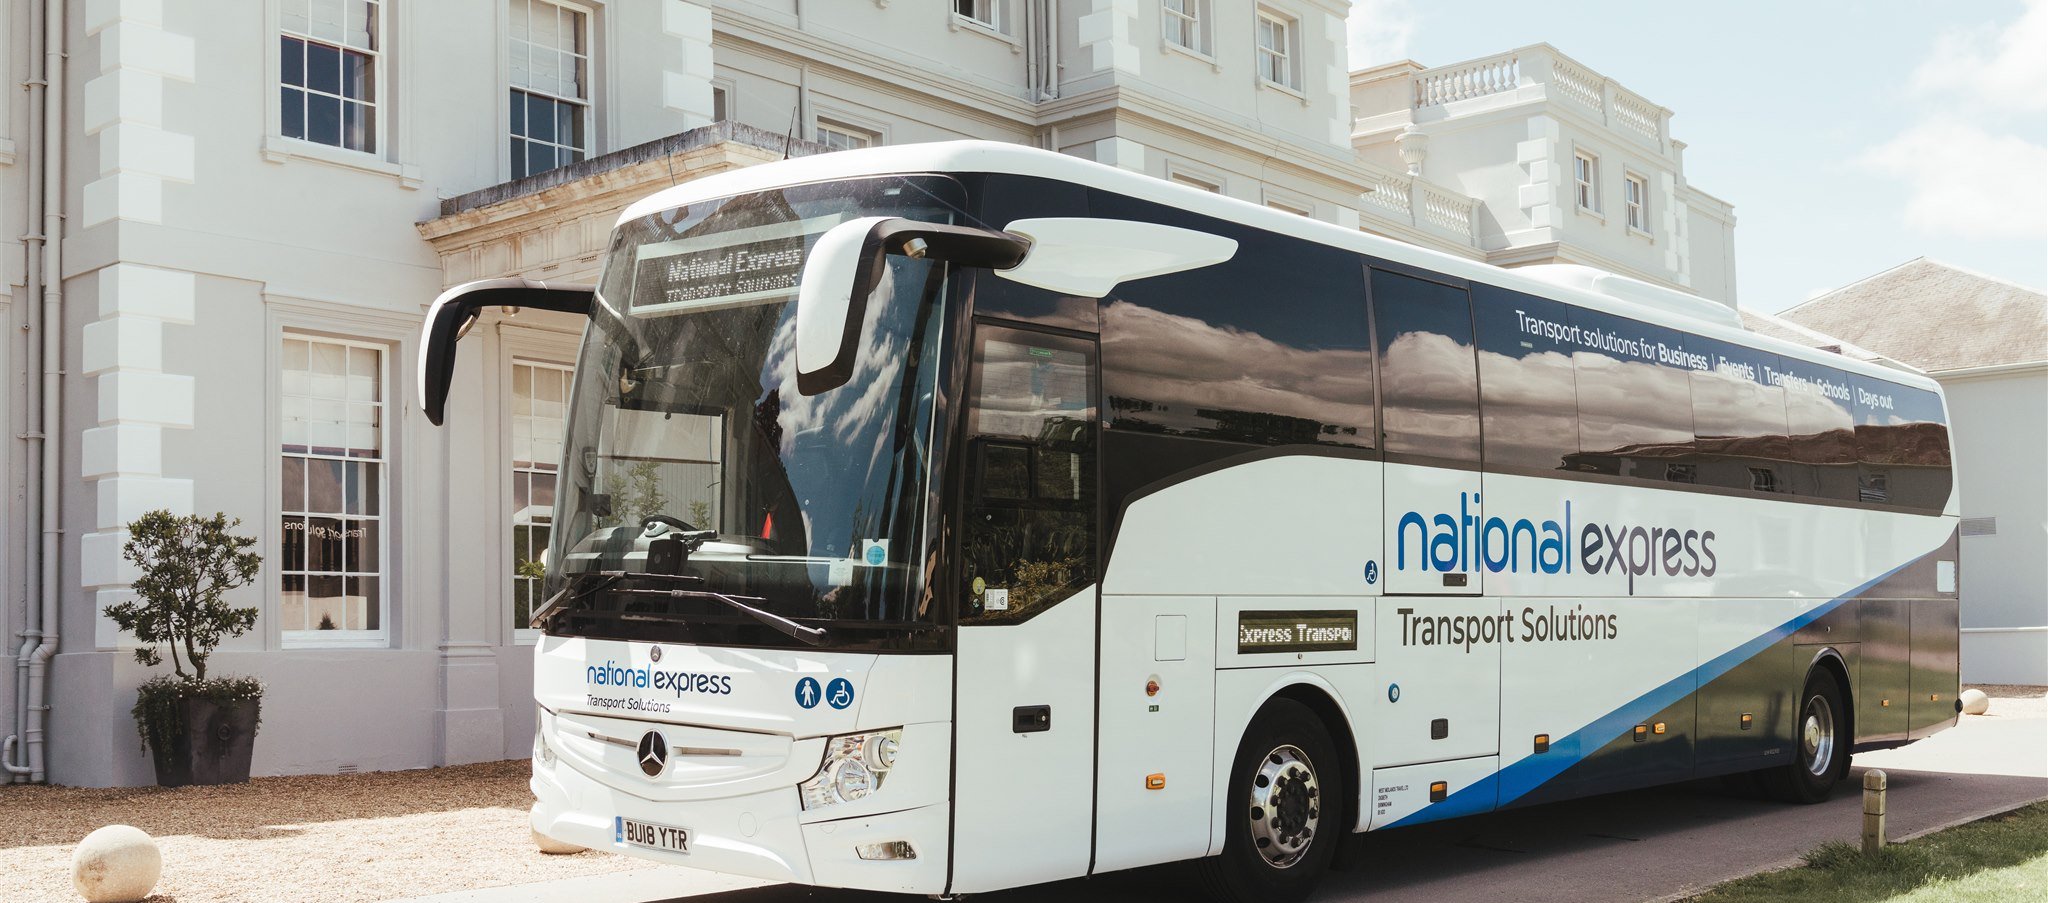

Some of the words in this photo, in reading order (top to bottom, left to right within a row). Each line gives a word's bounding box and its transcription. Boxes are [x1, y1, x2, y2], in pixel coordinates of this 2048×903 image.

[668, 253, 733, 282] National
[735, 249, 801, 273] Express
[1515, 309, 1582, 344] Transport
[1583, 327, 1639, 355] solutions
[1639, 338, 1656, 360] for
[1657, 342, 1709, 371] Business
[1719, 356, 1755, 380] Events
[1763, 366, 1808, 392] Transfers
[1816, 378, 1851, 401] Schools
[1858, 387, 1879, 410] Days
[1879, 394, 1894, 410] out
[1397, 491, 1571, 574] national
[1580, 522, 1717, 596] express
[1397, 607, 1514, 653] Transport
[1521, 604, 1618, 643] Solutions
[586, 660, 651, 689] national
[653, 670, 732, 698] express
[586, 694, 625, 711] Transport
[627, 697, 671, 714] Solutions
[626, 821, 655, 845] BU18
[658, 827, 687, 851] YTR
